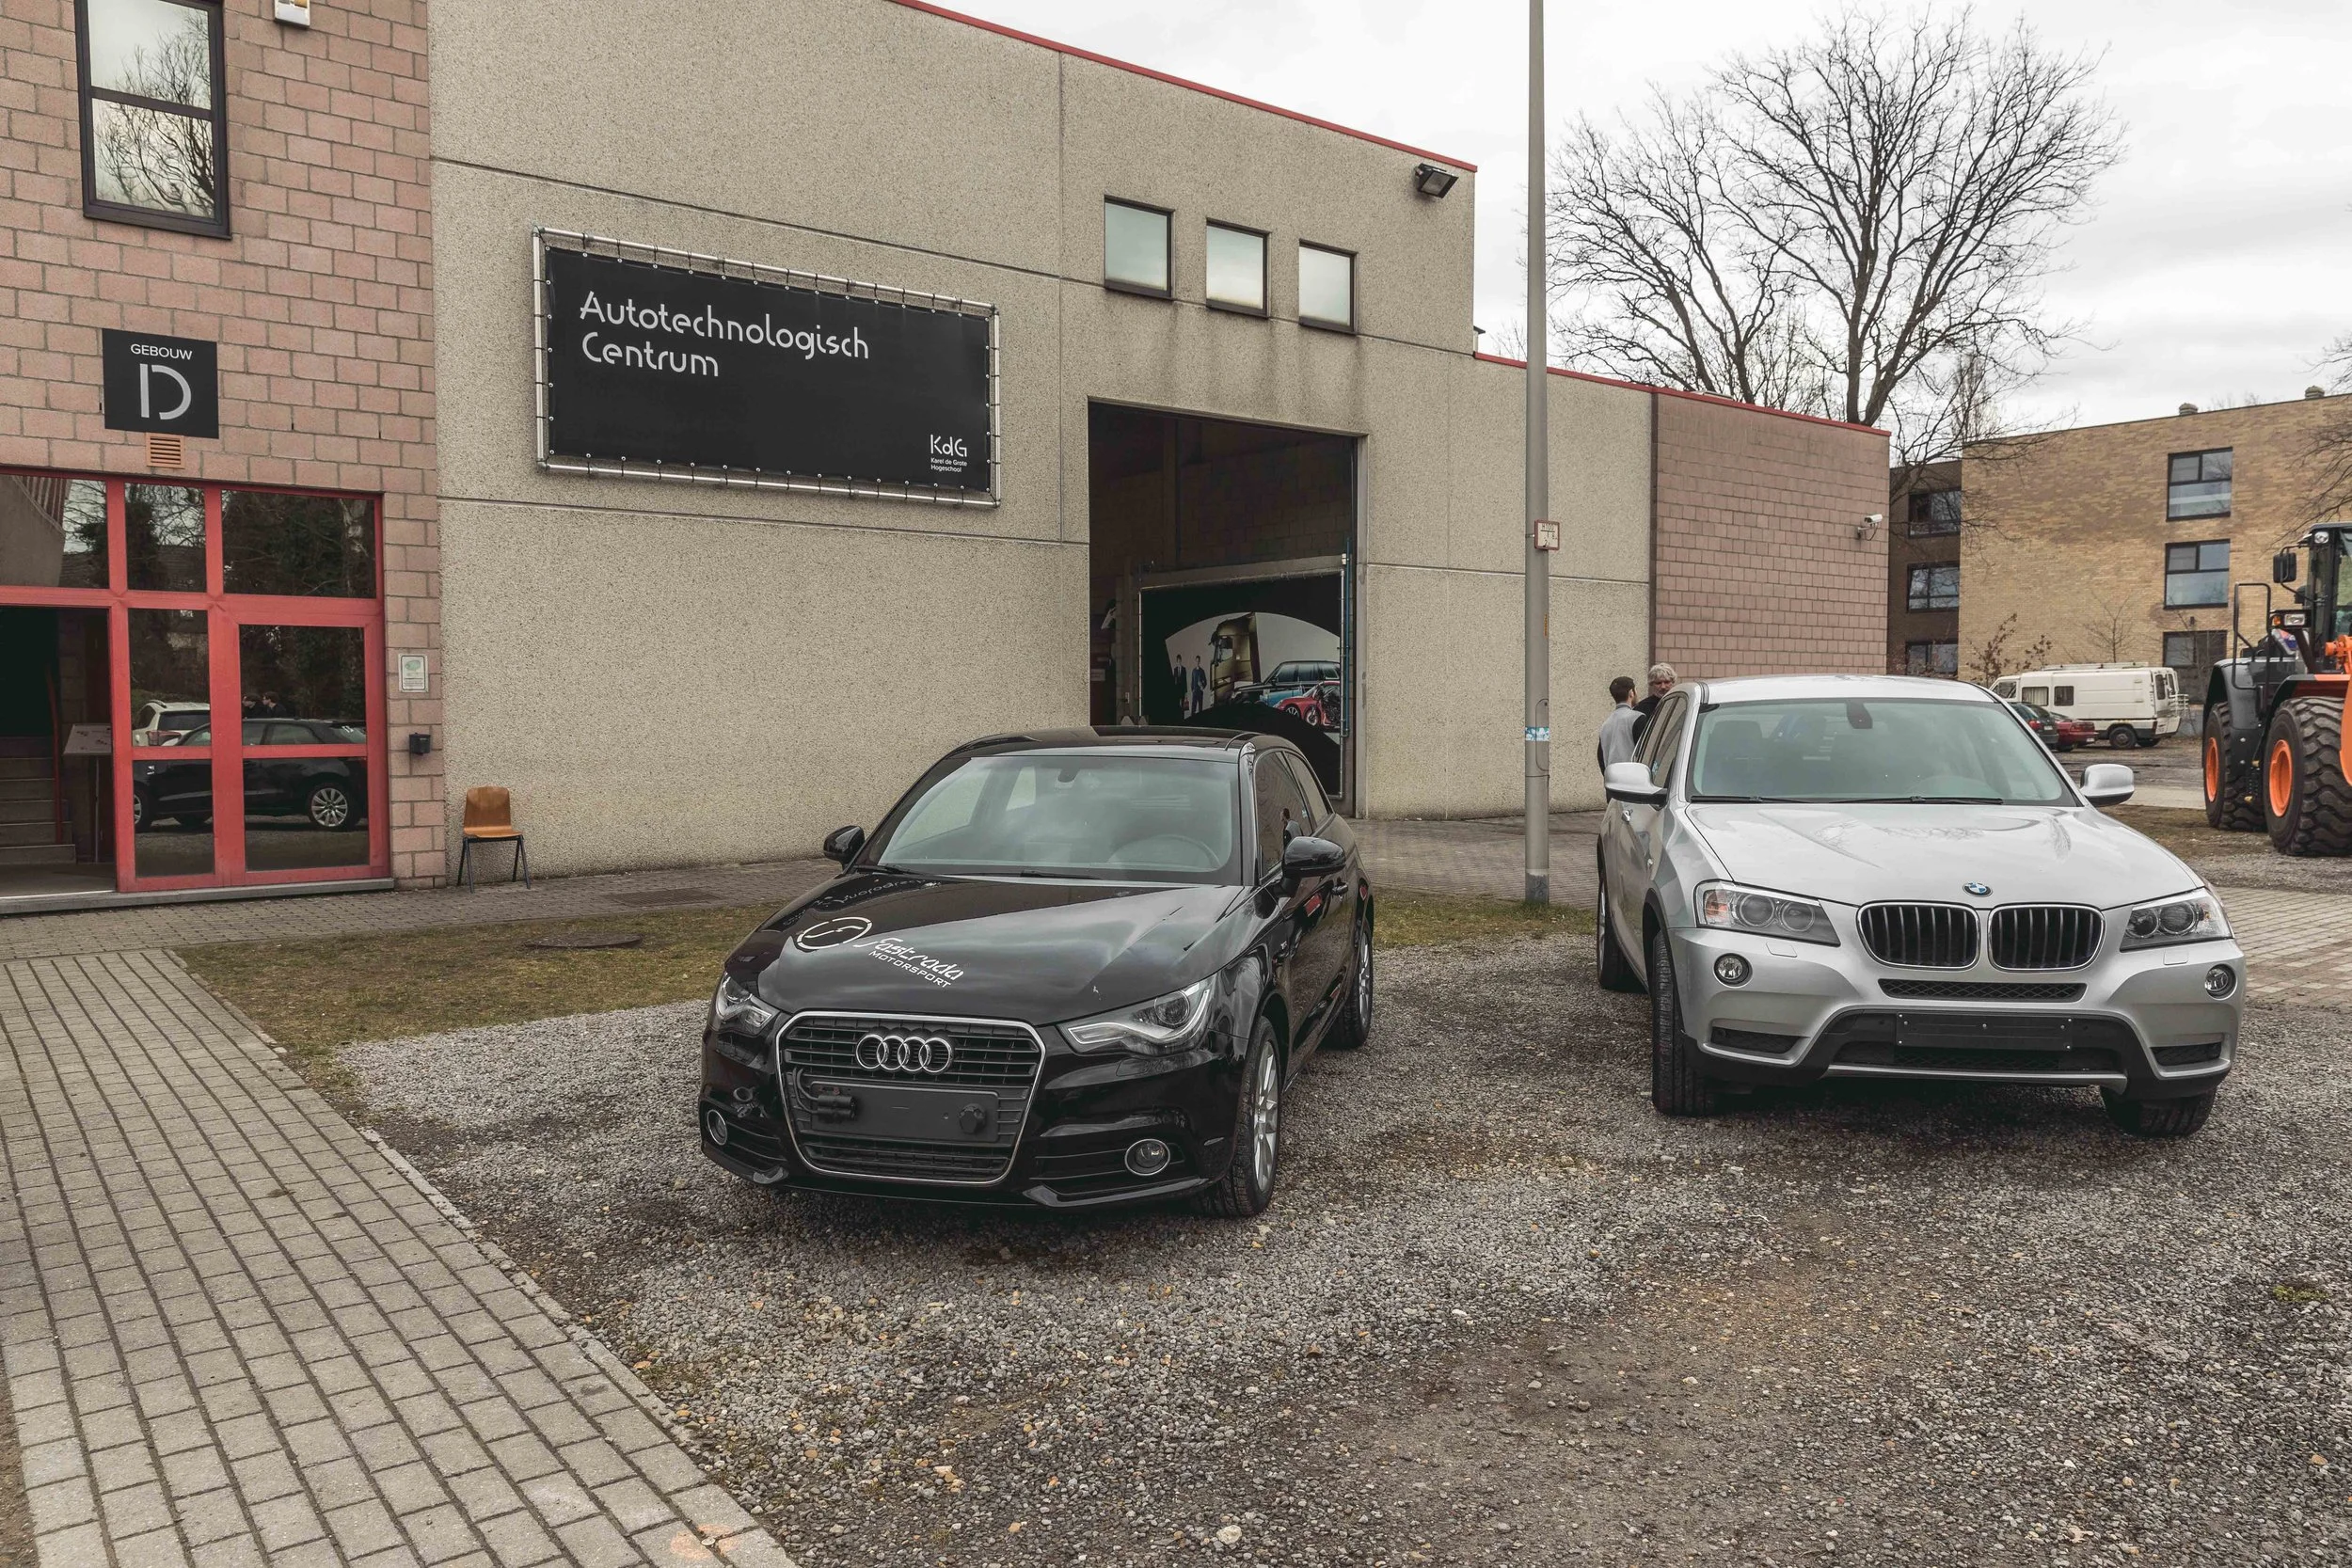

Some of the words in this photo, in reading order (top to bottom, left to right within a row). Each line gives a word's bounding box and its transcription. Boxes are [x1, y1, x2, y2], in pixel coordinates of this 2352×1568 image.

[580, 291, 868, 360] Autotechnologisch
[131, 343, 192, 360] GEBOUW
[581, 331, 718, 376] Centrum
[139, 363, 192, 420] D
[930, 434, 967, 457] KdG
[930, 464, 962, 472] Hogeschool
[868, 950, 951, 988] MOTORSPORT
